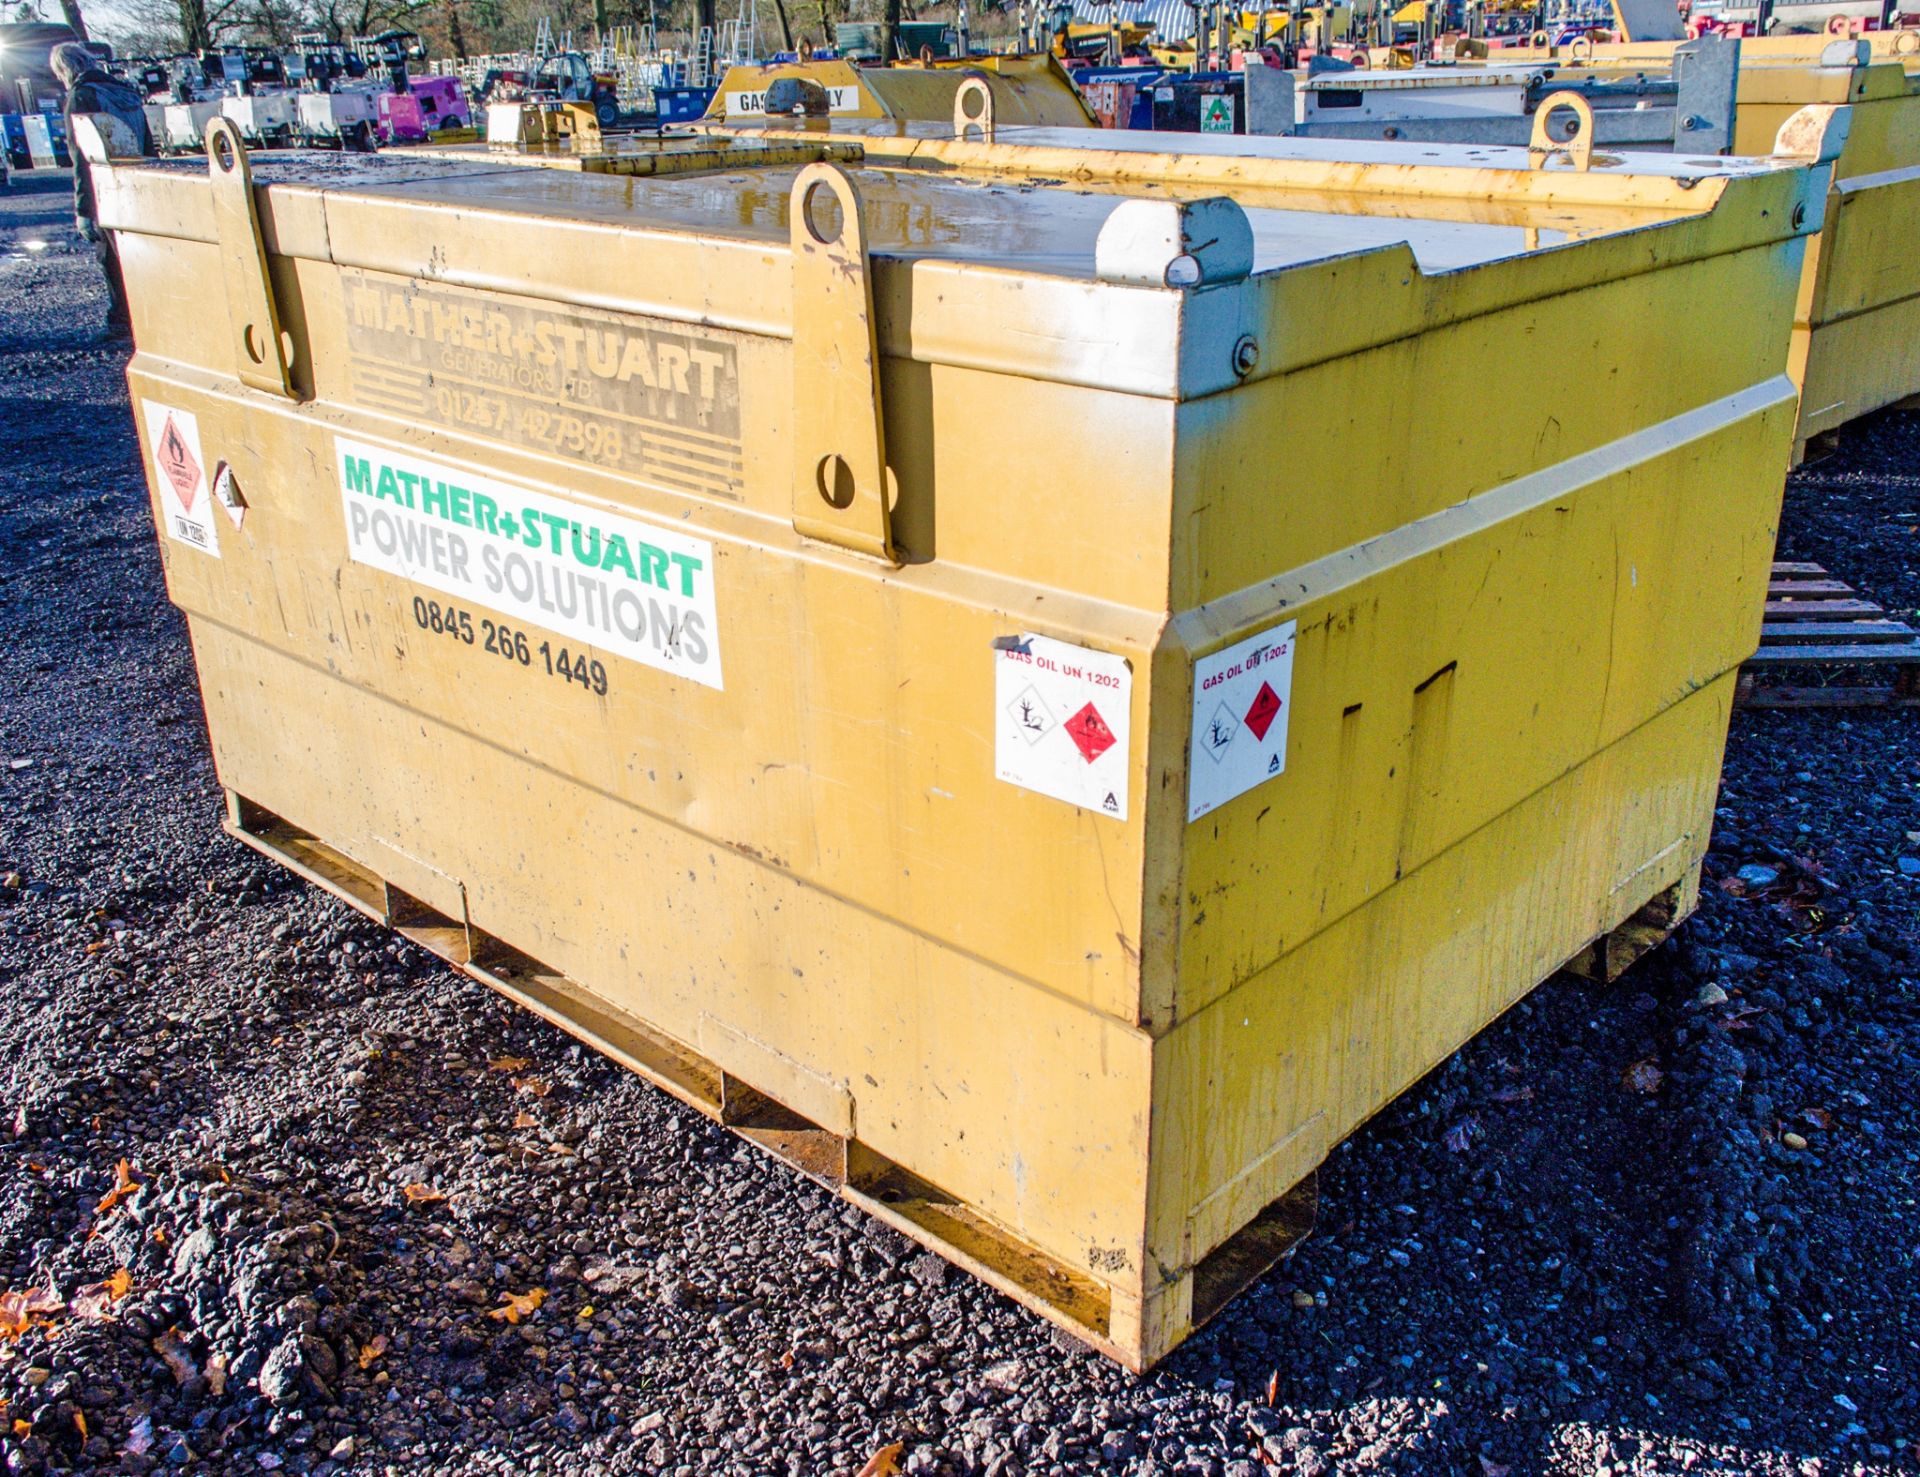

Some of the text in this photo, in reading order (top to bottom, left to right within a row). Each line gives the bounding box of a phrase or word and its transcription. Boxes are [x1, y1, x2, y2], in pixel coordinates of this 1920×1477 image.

[1203, 121, 1232, 132] PLANT
[352, 286, 724, 399] MATHER+STUART
[441, 350, 555, 393] GENERATORS
[344, 454, 703, 598] MATHER+STUART
[350, 501, 709, 665] POWER SOLUTIONS
[413, 596, 608, 696] 0845 266 1449
[1006, 648, 1120, 689] GAS OIL UN 1202
[1203, 671, 1224, 690] GAS
[1227, 664, 1243, 680] OIL
[1264, 644, 1288, 663] 1202
